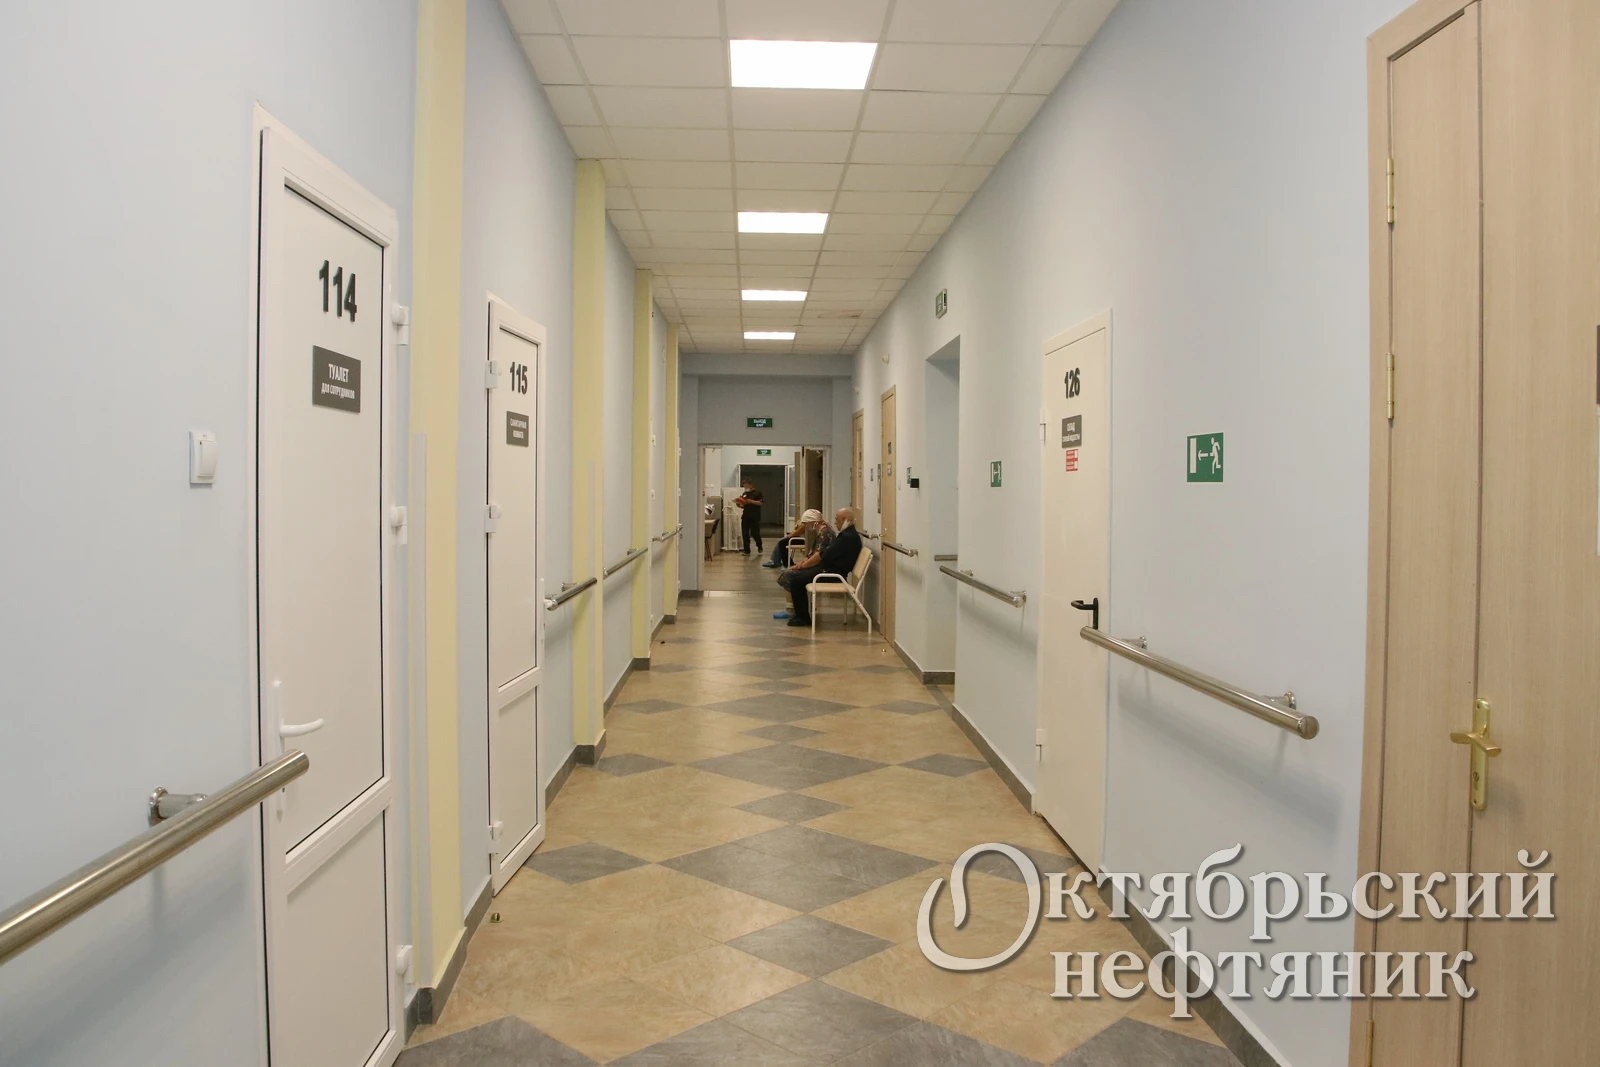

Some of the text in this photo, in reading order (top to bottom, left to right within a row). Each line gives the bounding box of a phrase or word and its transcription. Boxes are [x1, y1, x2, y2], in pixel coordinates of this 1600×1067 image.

[319, 260, 357, 322] 114
[321, 382, 330, 394] ДЛЯ
[328, 363, 349, 382] ТУАЛЕТ
[510, 362, 527, 394] 115
[1064, 367, 1080, 399] 126
